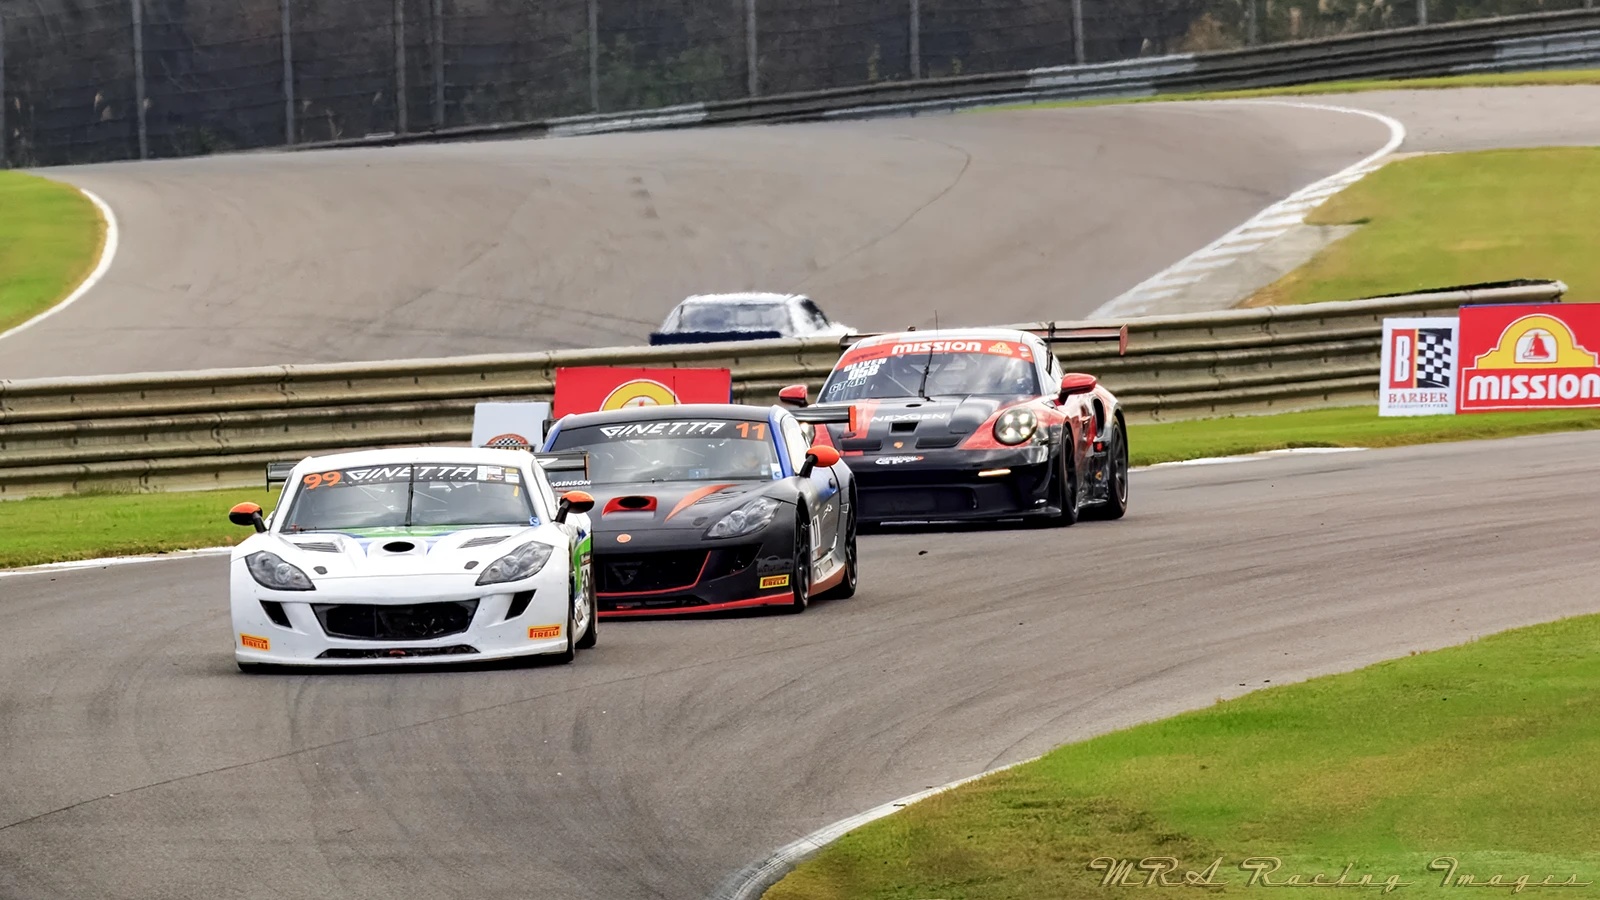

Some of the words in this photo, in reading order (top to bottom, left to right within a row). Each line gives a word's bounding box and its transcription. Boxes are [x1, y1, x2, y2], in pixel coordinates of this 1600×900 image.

[891, 341, 982, 355] MISSION
[1468, 374, 1600, 401] MISSION
[1388, 393, 1449, 403] BARBER
[600, 422, 727, 437] GINETTA
[736, 422, 765, 440] 11
[303, 471, 342, 490] 99
[346, 466, 477, 480] GINETTA
[529, 626, 560, 639] PIRELLI
[241, 635, 268, 650] PIRELLI
